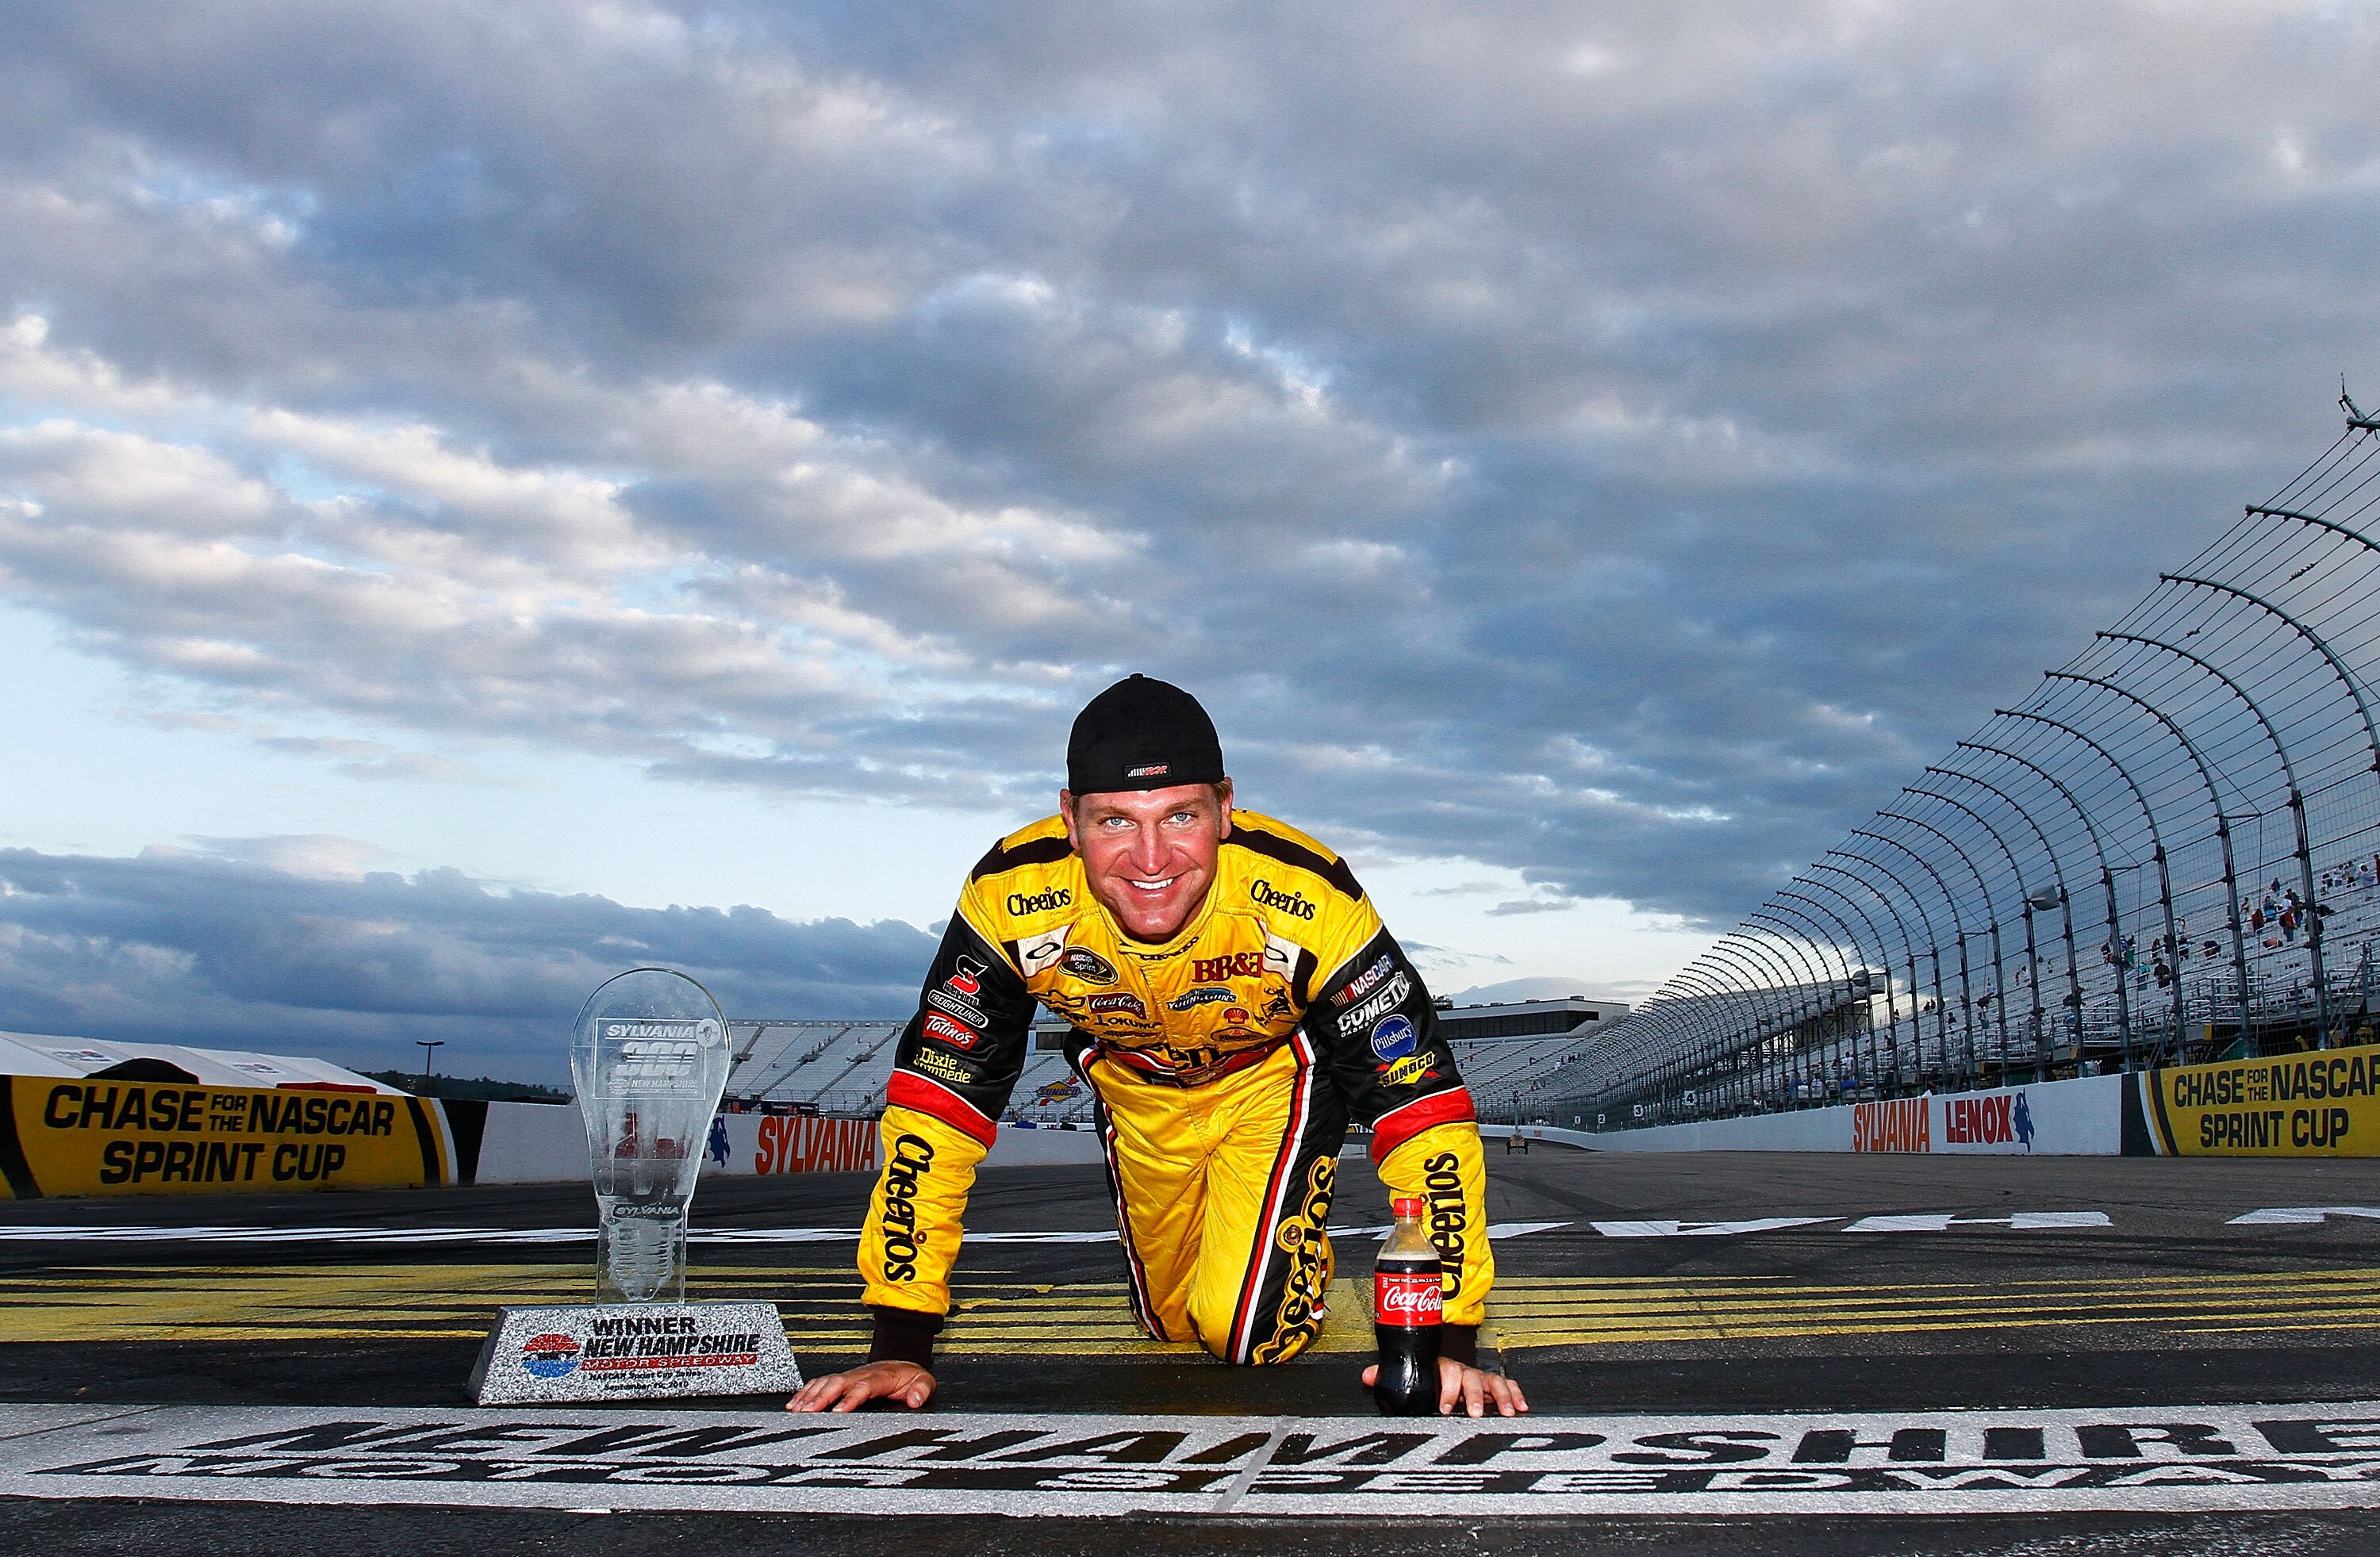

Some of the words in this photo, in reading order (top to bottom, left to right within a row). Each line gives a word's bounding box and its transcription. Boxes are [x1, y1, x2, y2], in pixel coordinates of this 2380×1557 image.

[1008, 886, 1071, 916] Cheeios
[1350, 953, 1394, 998] NASCAR
[931, 993, 983, 1024] FREIGHTLINER
[607, 1024, 695, 1037] SYLVANIA
[927, 1015, 974, 1044] Totino's
[1374, 1025, 1411, 1050] Pillsbury
[919, 1047, 958, 1070] Dixie
[1381, 1052, 1434, 1087] SUNOCO
[2175, 1068, 2244, 1107] CHASE
[2248, 1068, 2268, 1083] FOR
[211, 1093, 246, 1111] FOR
[1039, 1087, 1078, 1096] SUNOCO
[1686, 1092, 1694, 1103] 4
[2248, 1087, 2267, 1101] THE
[44, 1084, 206, 1132] CHASE
[247, 1095, 395, 1136] NASCAR
[209, 1114, 243, 1132] THE
[1853, 1098, 1930, 1152] SYLVANIA
[1945, 1095, 2013, 1144] LENOX
[2200, 1111, 2284, 1148] SPRINT
[2292, 1108, 2349, 1148] CUP
[755, 1116, 876, 1175] SYLVANIA
[101, 1141, 267, 1184] SPRINT
[273, 1143, 346, 1180] CUP
[883, 1134, 935, 1282] Cheerios
[593, 1317, 697, 1336] WINNER
[584, 1336, 636, 1358] NEW
[638, 1333, 760, 1356] HAMPSHIRE
[585, 1359, 650, 1370] MOTOR
[658, 1355, 756, 1367] SPEEDWAY
[628, 1371, 655, 1379] Sprint
[656, 1370, 674, 1379] Cup
[604, 1382, 651, 1391] September
[175, 1421, 850, 1458] NEW
[807, 1418, 2380, 1466] HAMPSHIRE
[79, 1456, 931, 1487] MOTOR
[1035, 1461, 2380, 1494] SPEEDWAY
